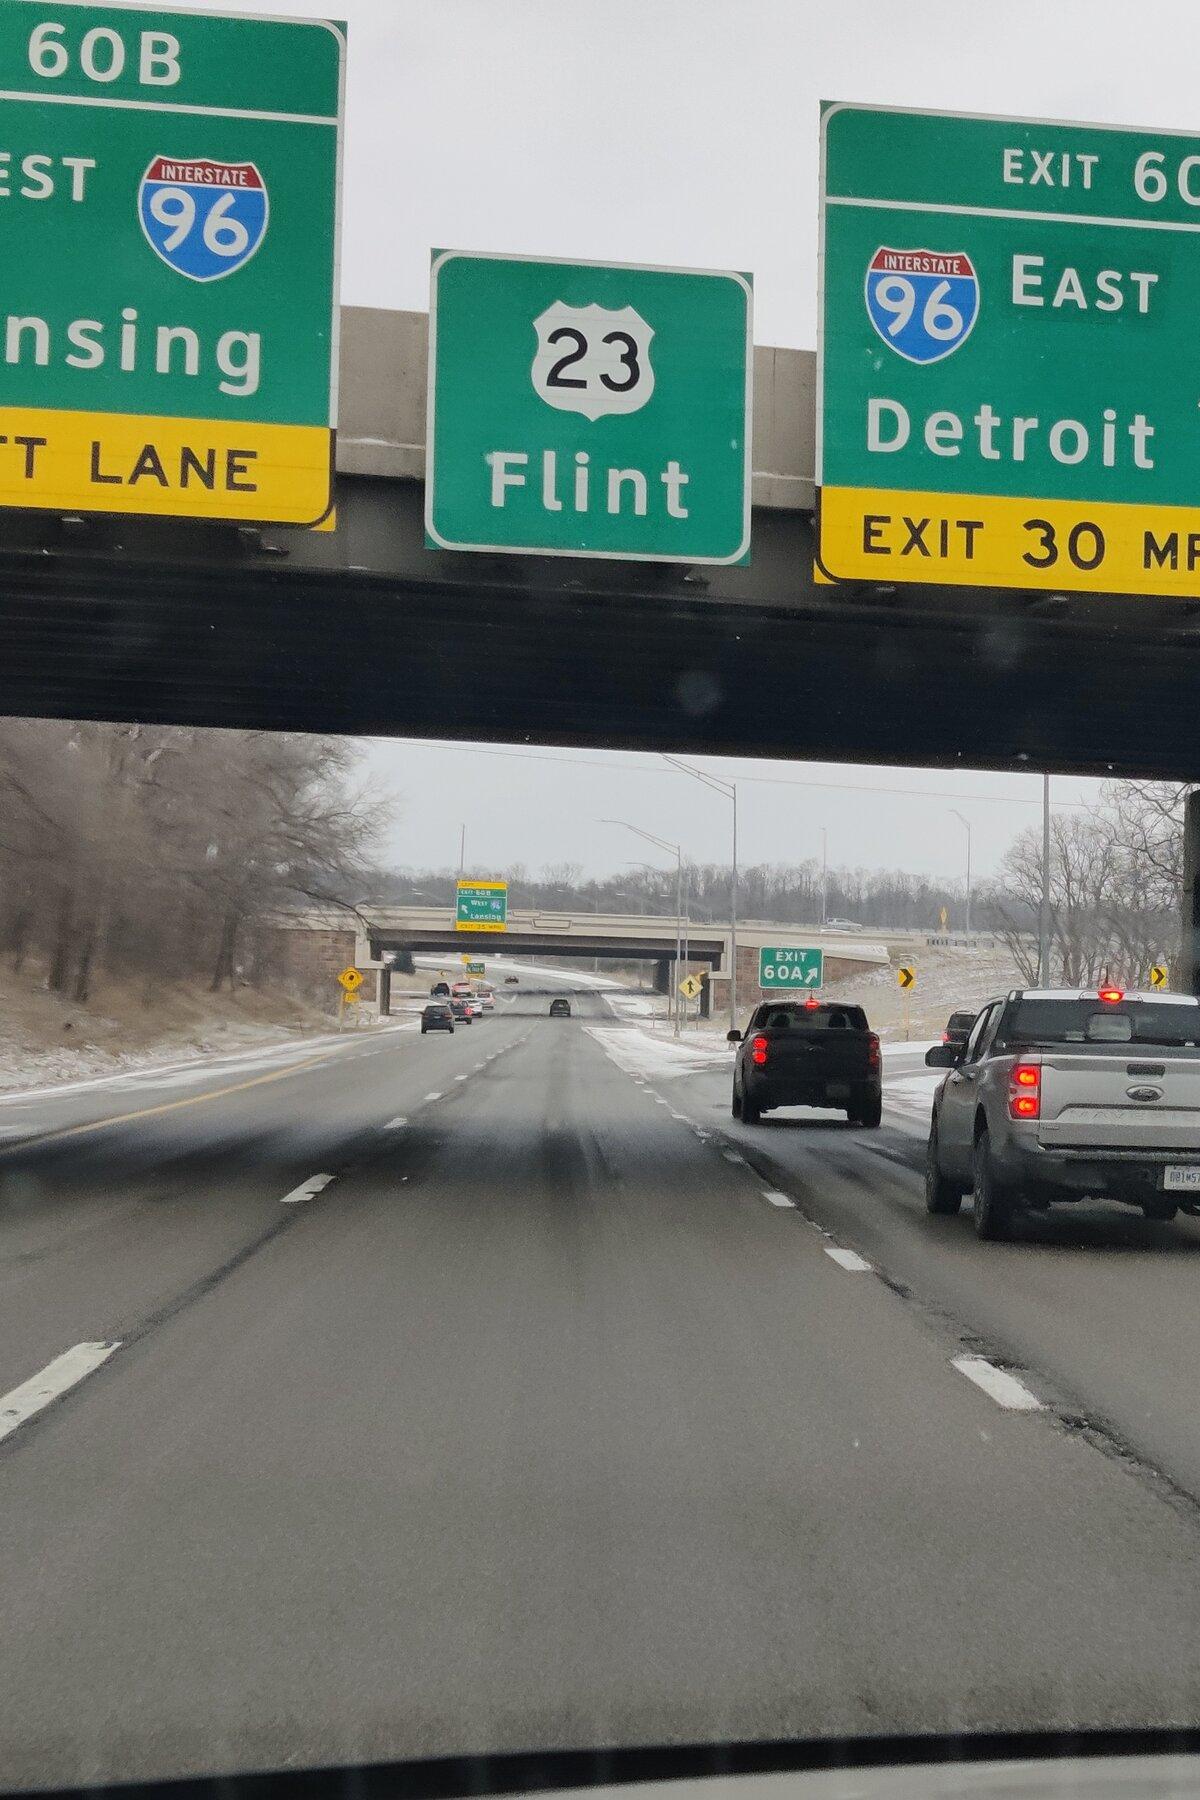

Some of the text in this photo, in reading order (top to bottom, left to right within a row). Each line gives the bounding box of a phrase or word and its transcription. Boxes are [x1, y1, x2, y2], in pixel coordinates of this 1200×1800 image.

[29, 22, 181, 86] 60B
[160, 164, 248, 187] INTERSTATE
[1003, 149, 1099, 189] EXIT
[150, 187, 249, 257] 96
[884, 254, 960, 275] INTERSTATE
[1012, 254, 1158, 313] EAST
[875, 276, 963, 341] 96
[6, 307, 260, 396] nsing
[546, 327, 640, 392] 23
[867, 398, 1154, 469] Detroit
[0, 435, 257, 492] T LANE
[491, 450, 689, 518] Flint
[863, 515, 984, 559] EXIT
[1022, 519, 1105, 571] 30
[764, 965, 803, 980] 60A
[776, 951, 807, 962] EXIT
